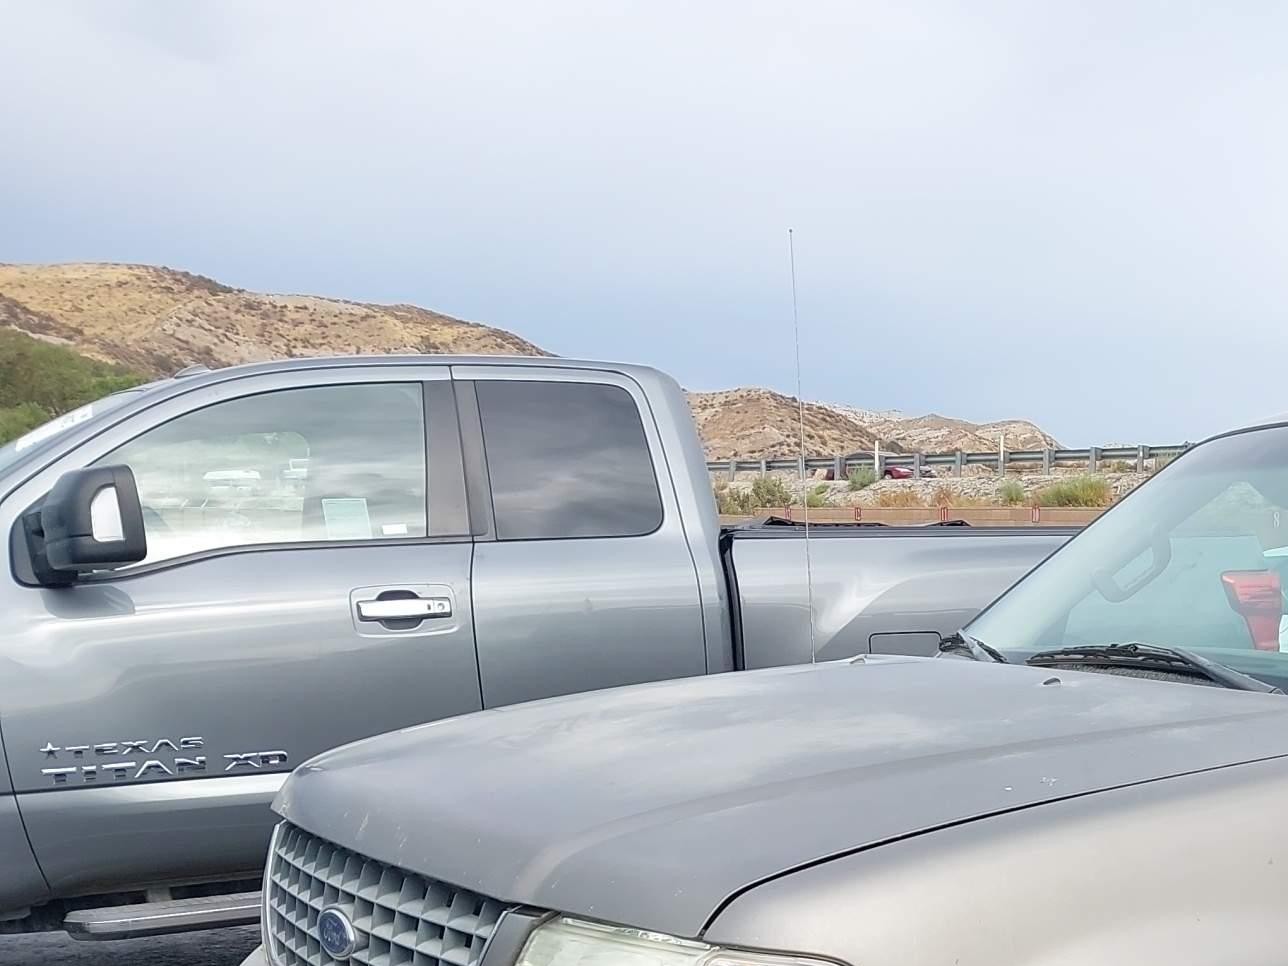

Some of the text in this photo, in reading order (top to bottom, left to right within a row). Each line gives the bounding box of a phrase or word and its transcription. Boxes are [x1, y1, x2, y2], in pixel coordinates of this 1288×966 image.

[65, 736, 205, 759] TEXAS
[41, 750, 288, 784] TITAN XD
